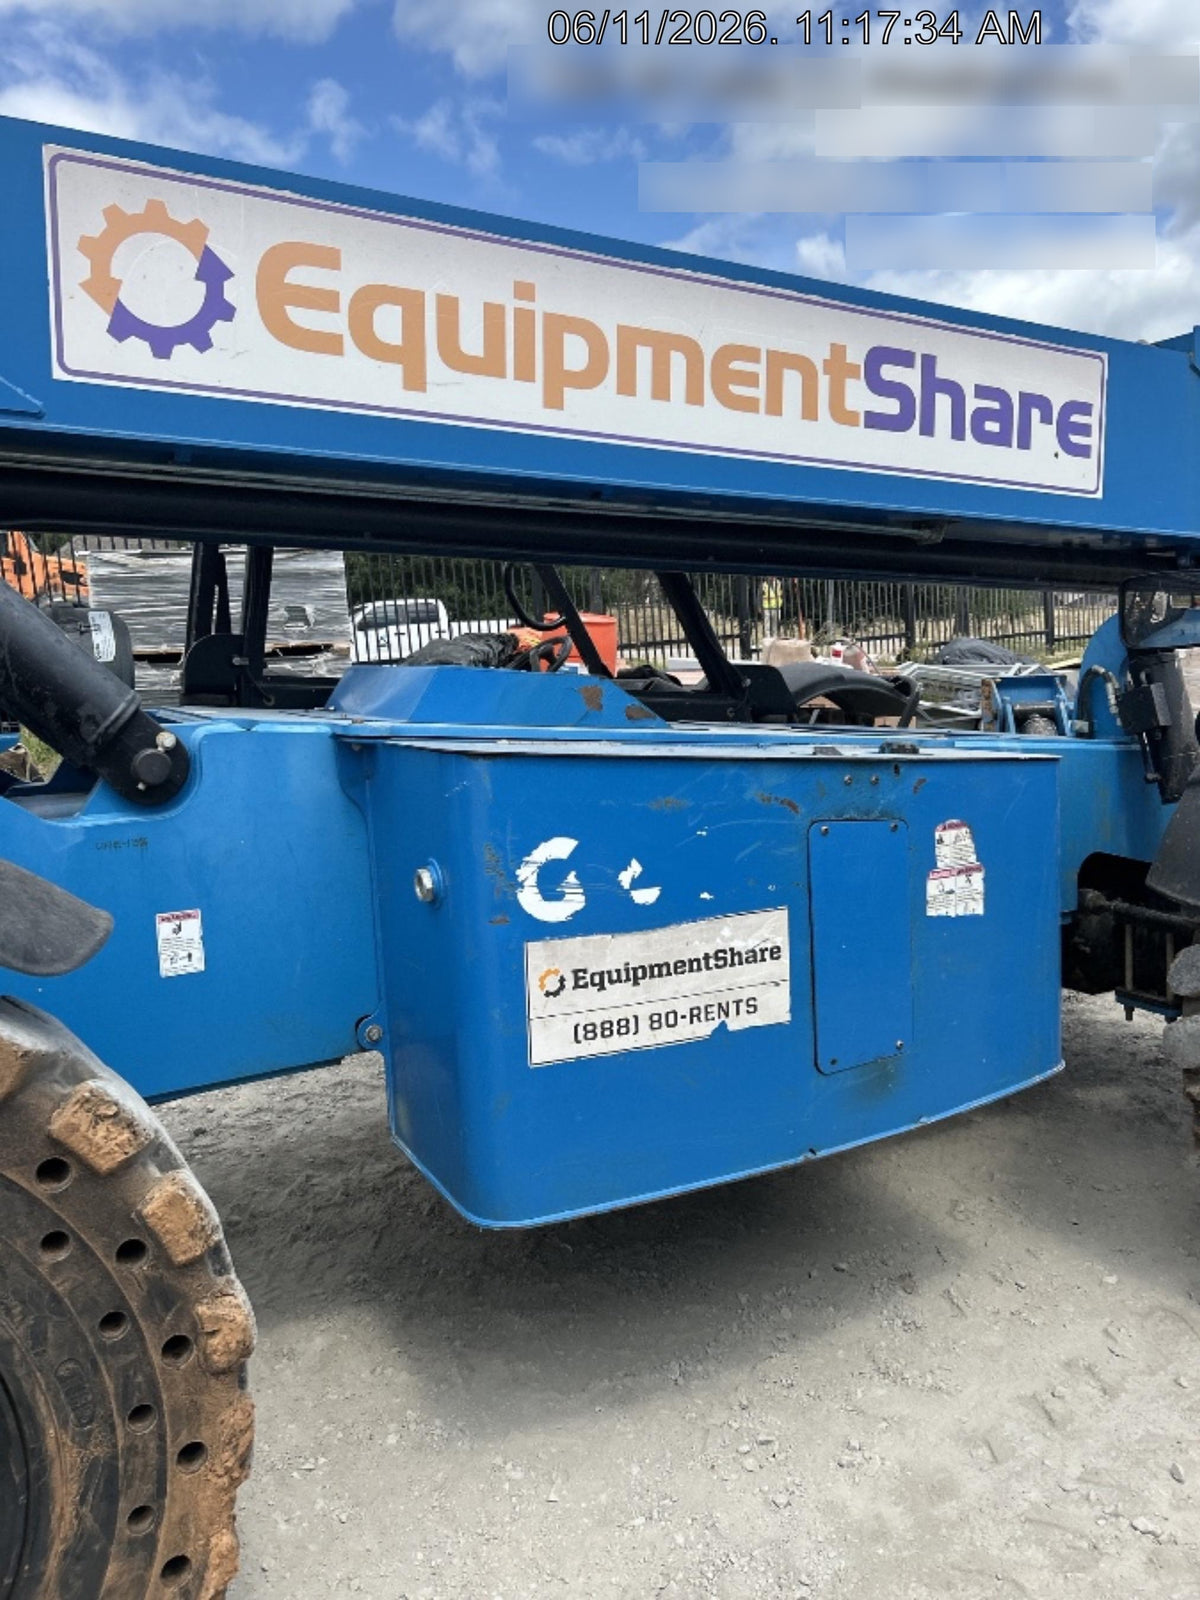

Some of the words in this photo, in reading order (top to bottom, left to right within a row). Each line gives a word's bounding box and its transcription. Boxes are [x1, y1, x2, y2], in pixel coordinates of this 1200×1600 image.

[255, 241, 1093, 459] EquipmentShare
[572, 944, 782, 992] EquipmentShare
[573, 1014, 639, 1044] (888)
[649, 996, 758, 1031] 80-RENTS
